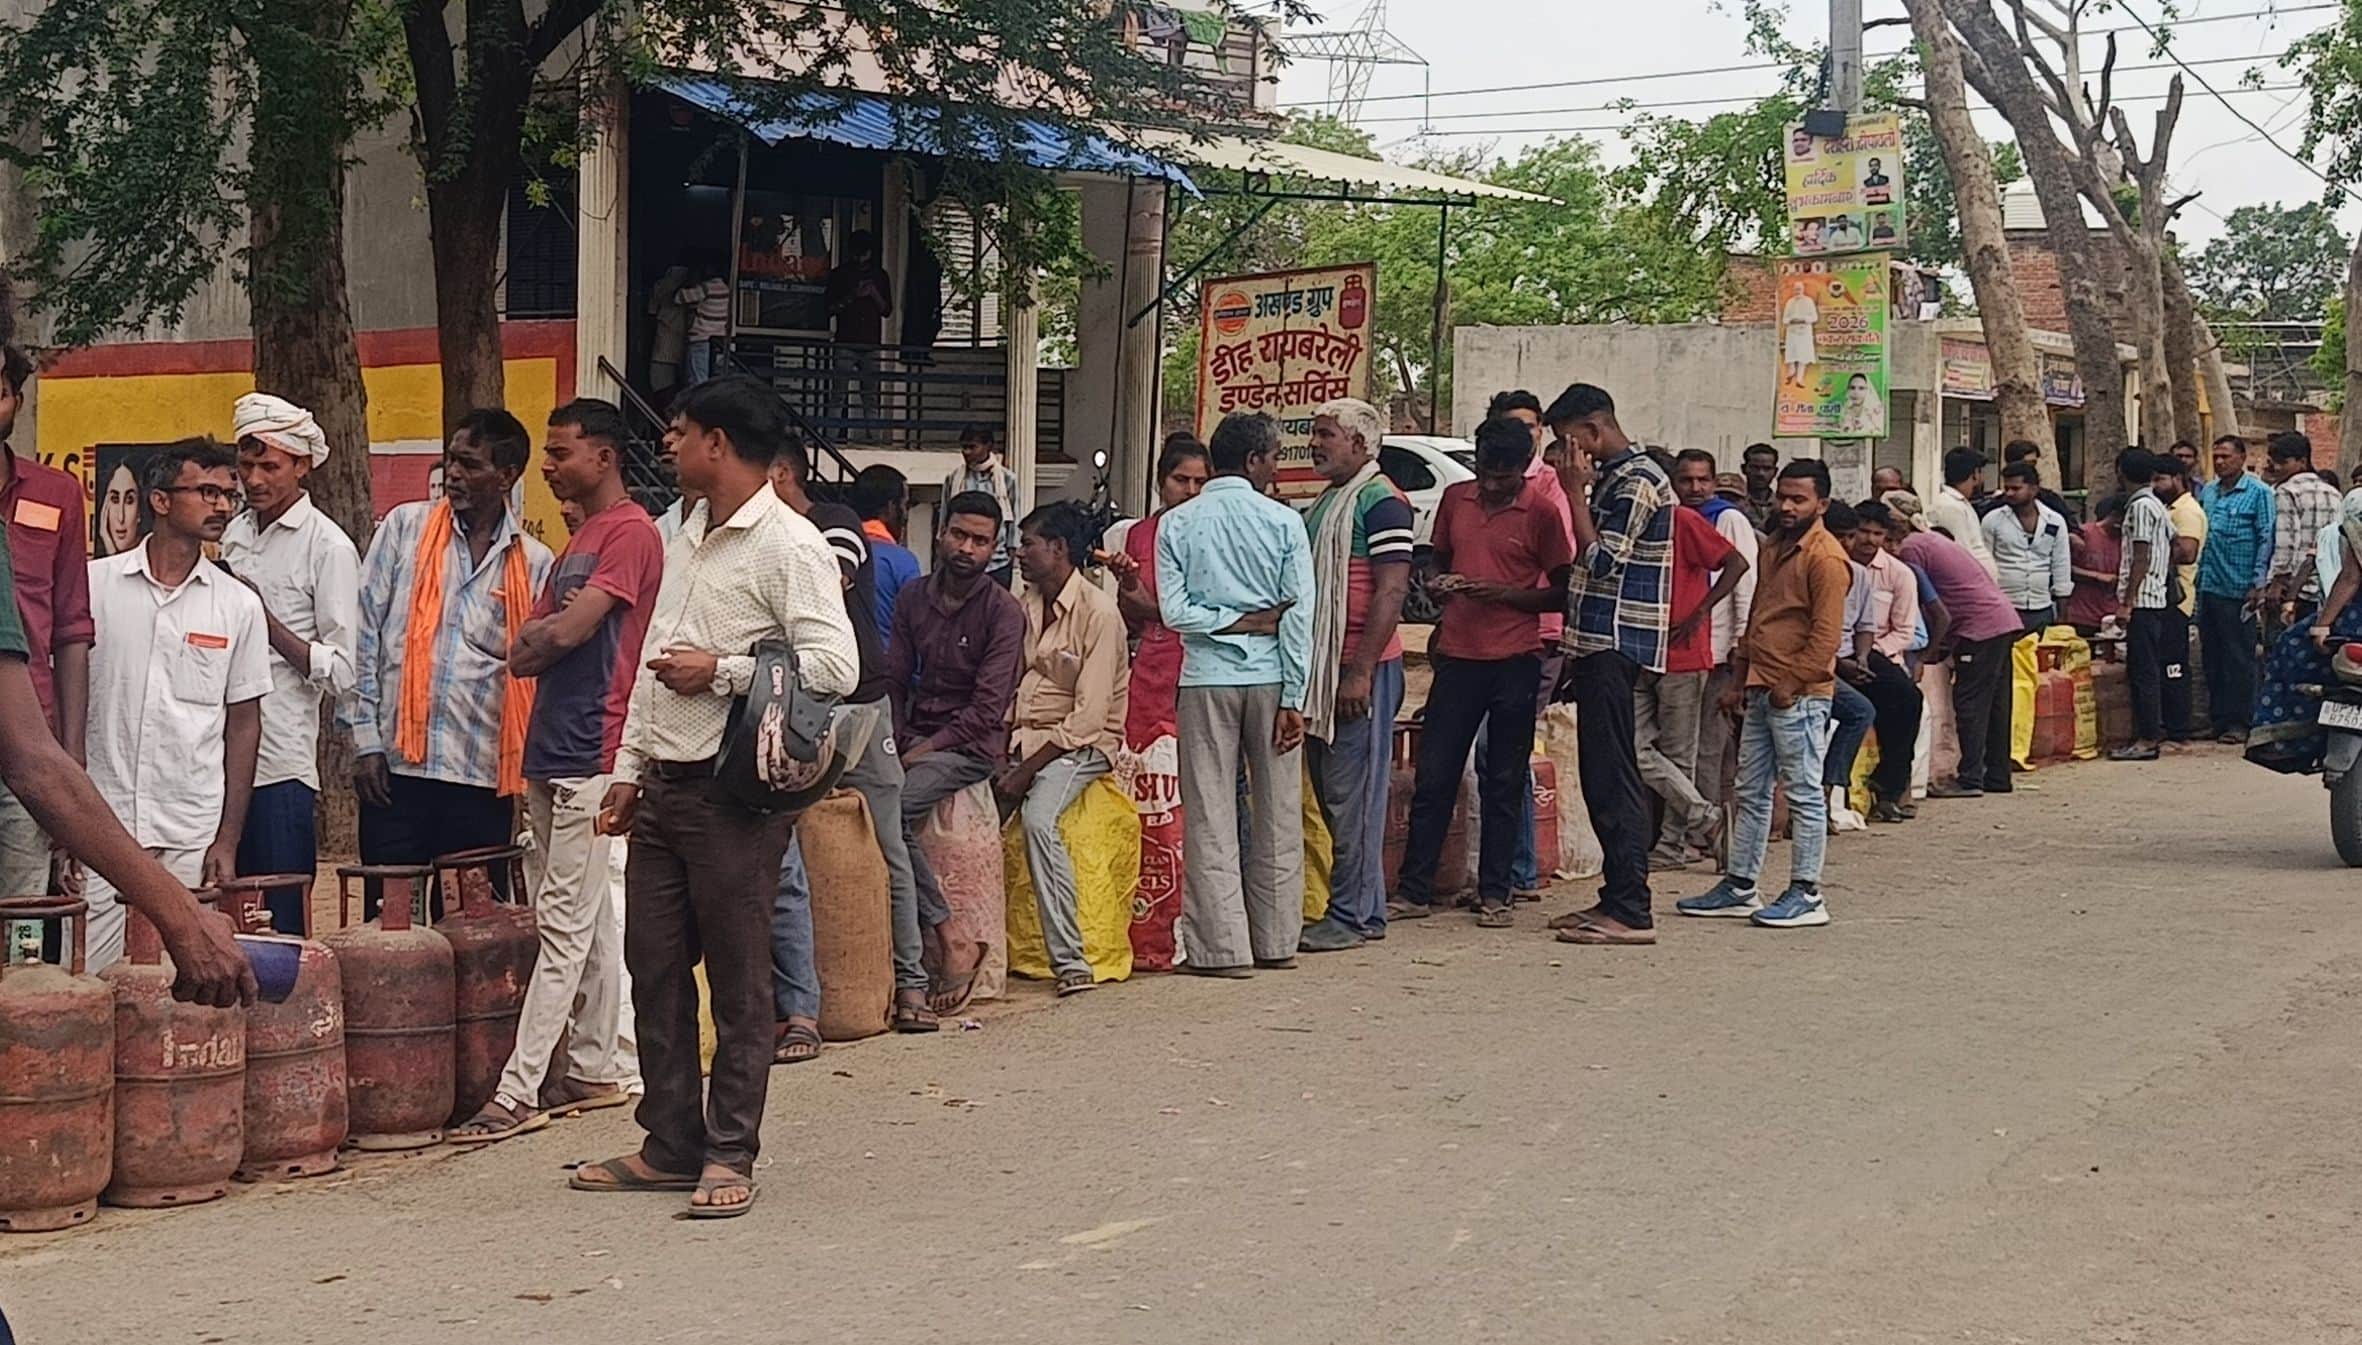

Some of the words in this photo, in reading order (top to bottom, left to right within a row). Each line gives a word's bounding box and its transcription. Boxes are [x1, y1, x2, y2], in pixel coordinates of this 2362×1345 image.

[1254, 290, 1304, 319] अखण्ड
[1306, 286, 1334, 318] ग्रुप
[1828, 316, 1869, 330] 2026
[1210, 340, 1253, 386] डीह
[1257, 323, 1363, 374] रायबरेली
[1283, 371, 1351, 405] सर्विस
